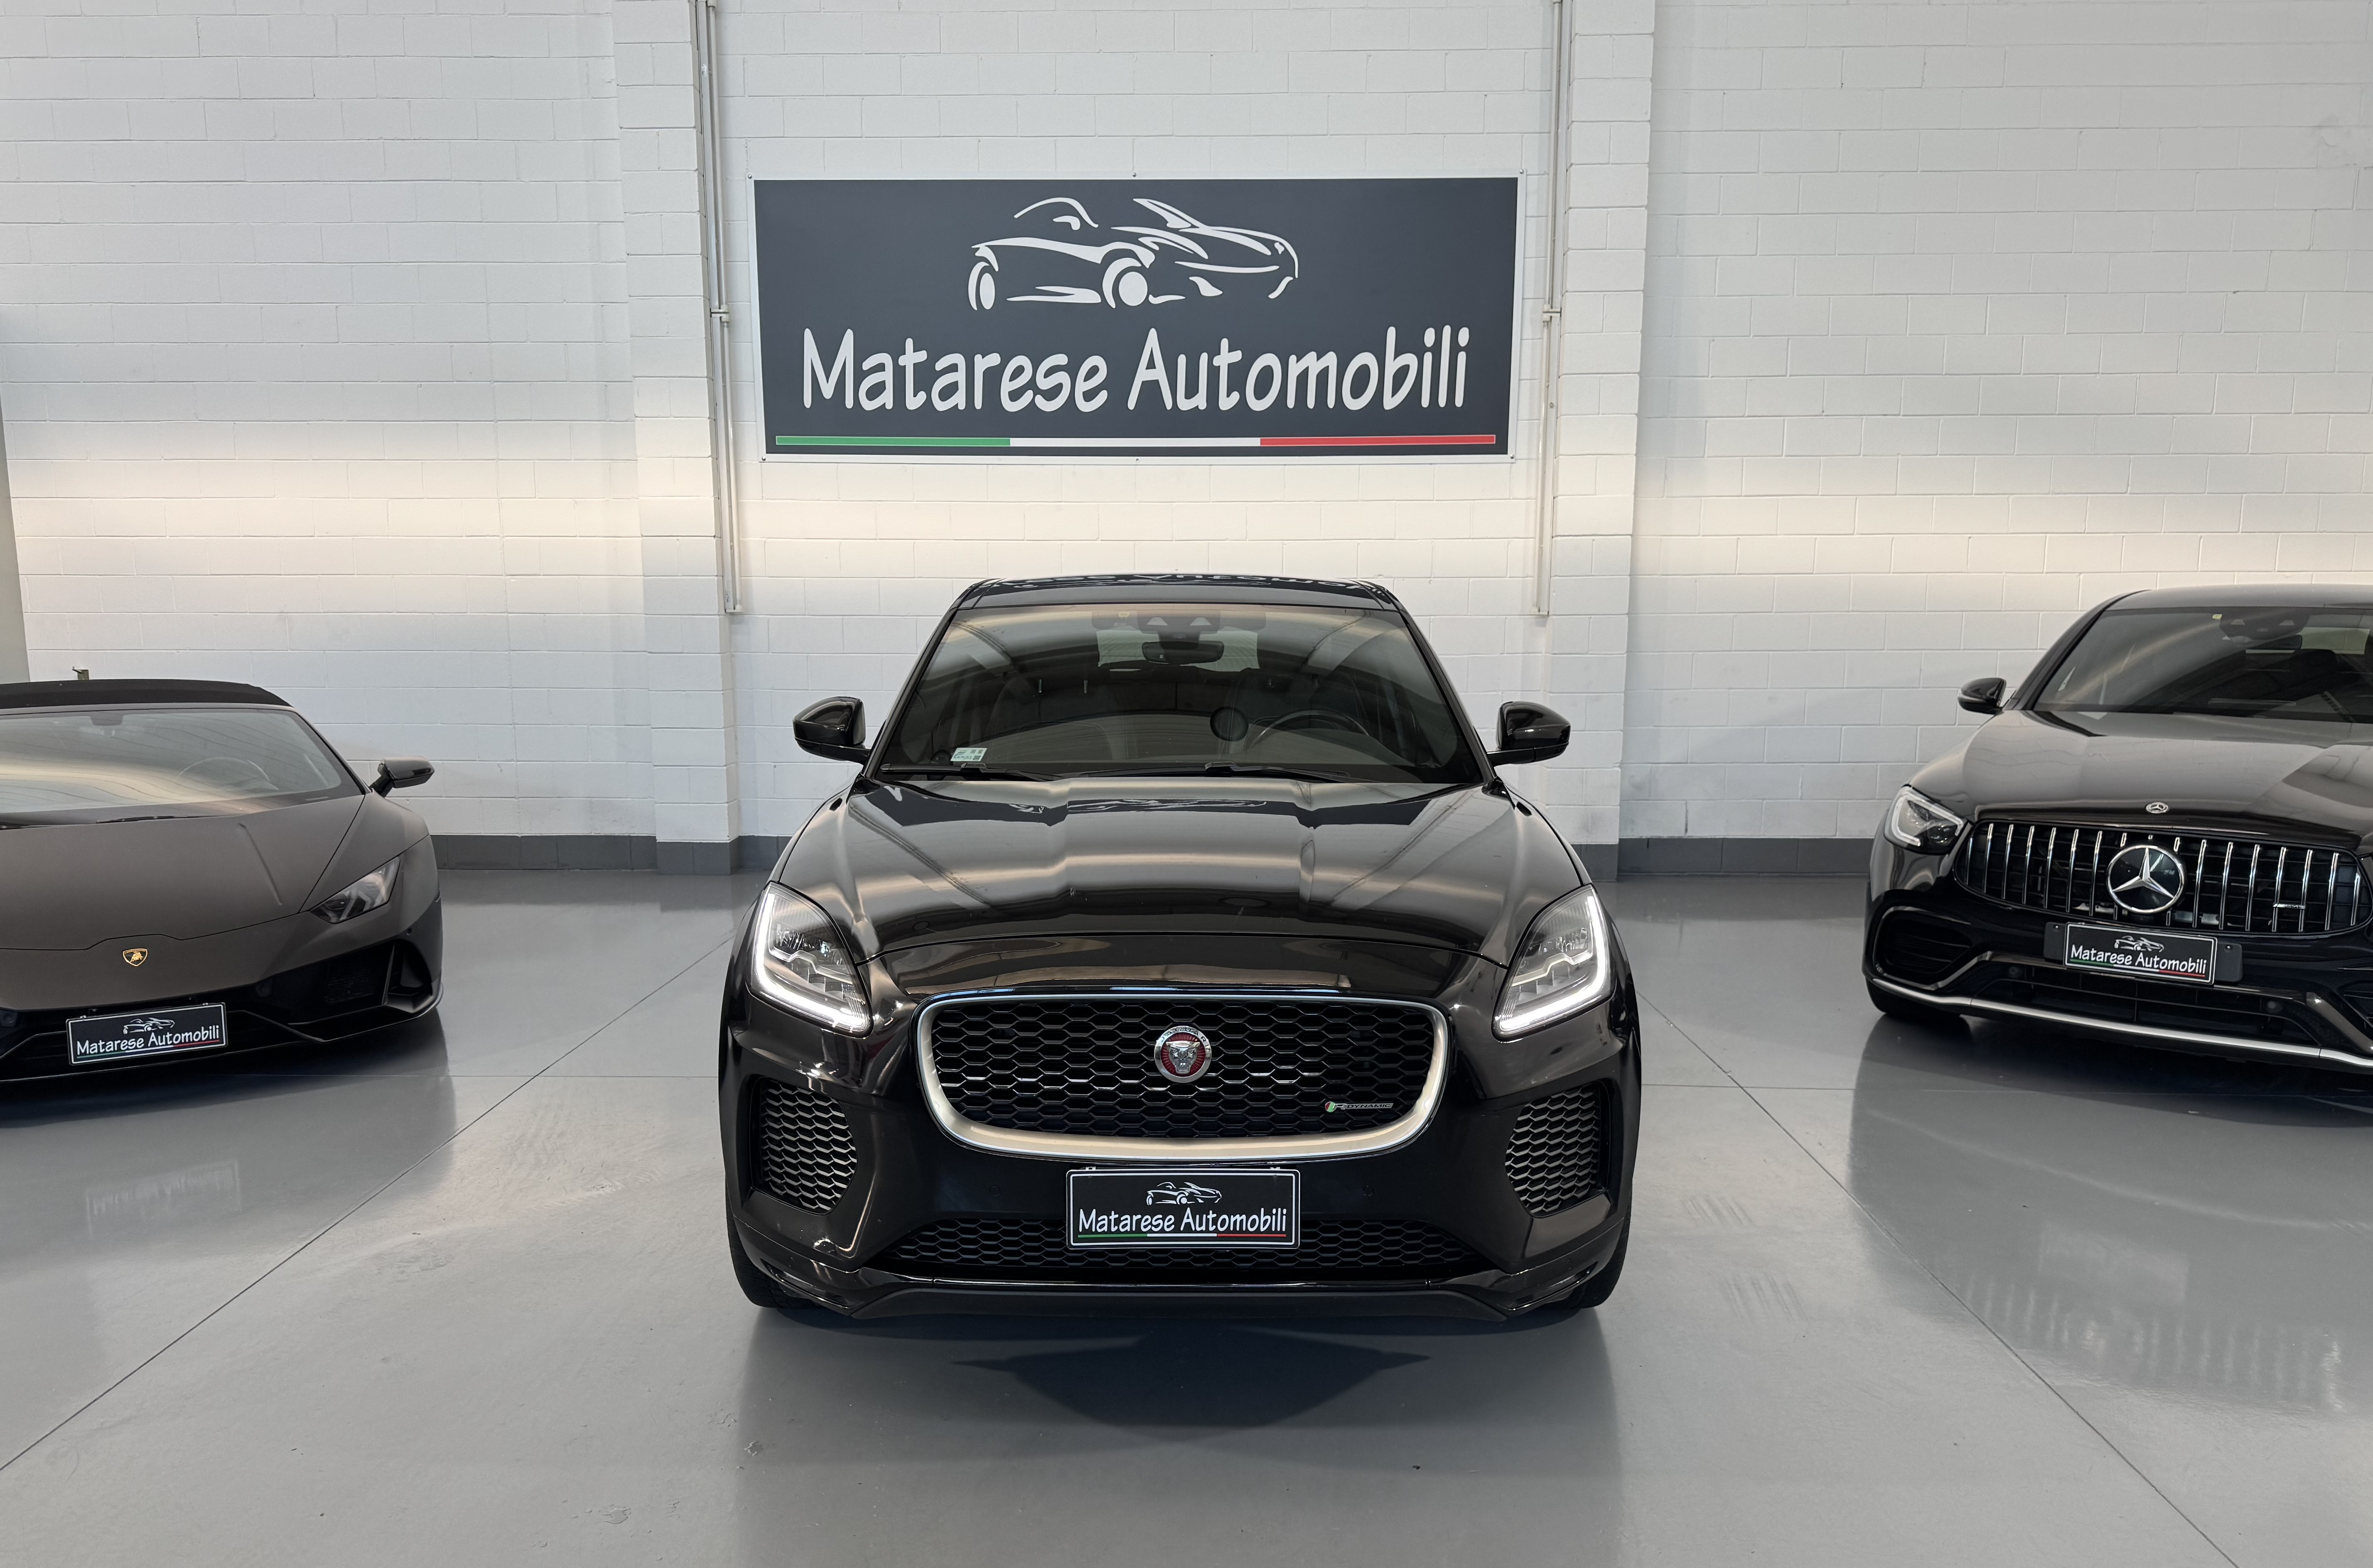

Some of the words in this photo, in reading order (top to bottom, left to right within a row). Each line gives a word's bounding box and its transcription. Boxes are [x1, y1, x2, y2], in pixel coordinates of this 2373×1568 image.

[803, 328, 1108, 412] Matarese
[1128, 325, 1469, 411] Automobili
[2071, 944, 2132, 965] Matarese
[2135, 952, 2207, 974] Automobili
[77, 1038, 145, 1055] Matarese
[148, 1025, 219, 1047] Automobili
[1079, 1208, 1175, 1233] Matarese
[1180, 1207, 1287, 1232] Automobili
